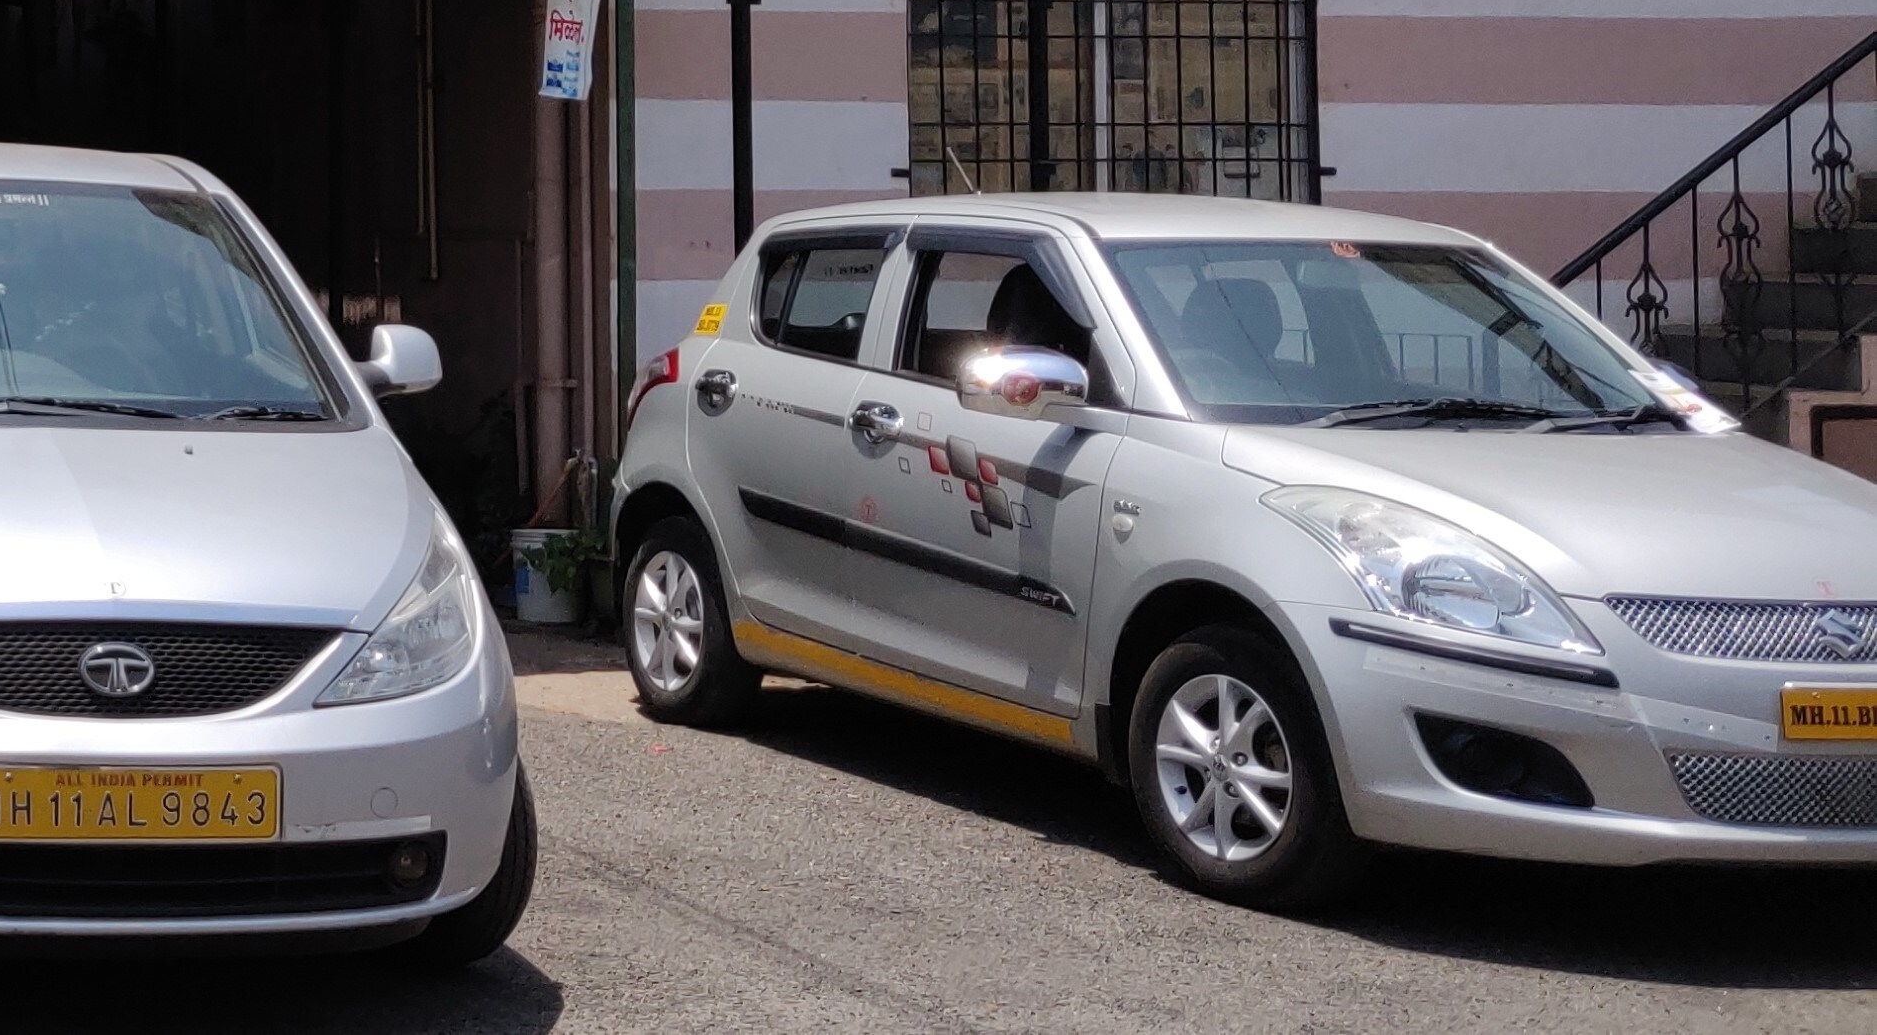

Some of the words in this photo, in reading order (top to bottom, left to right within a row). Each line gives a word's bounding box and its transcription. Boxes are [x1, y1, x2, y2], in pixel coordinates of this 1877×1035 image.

[1021, 586, 1061, 607] SWIFT
[55, 773, 84, 787] ALL
[90, 773, 136, 787] INDIA
[142, 772, 205, 787] PERMIT
[161, 790, 267, 826] 9843
